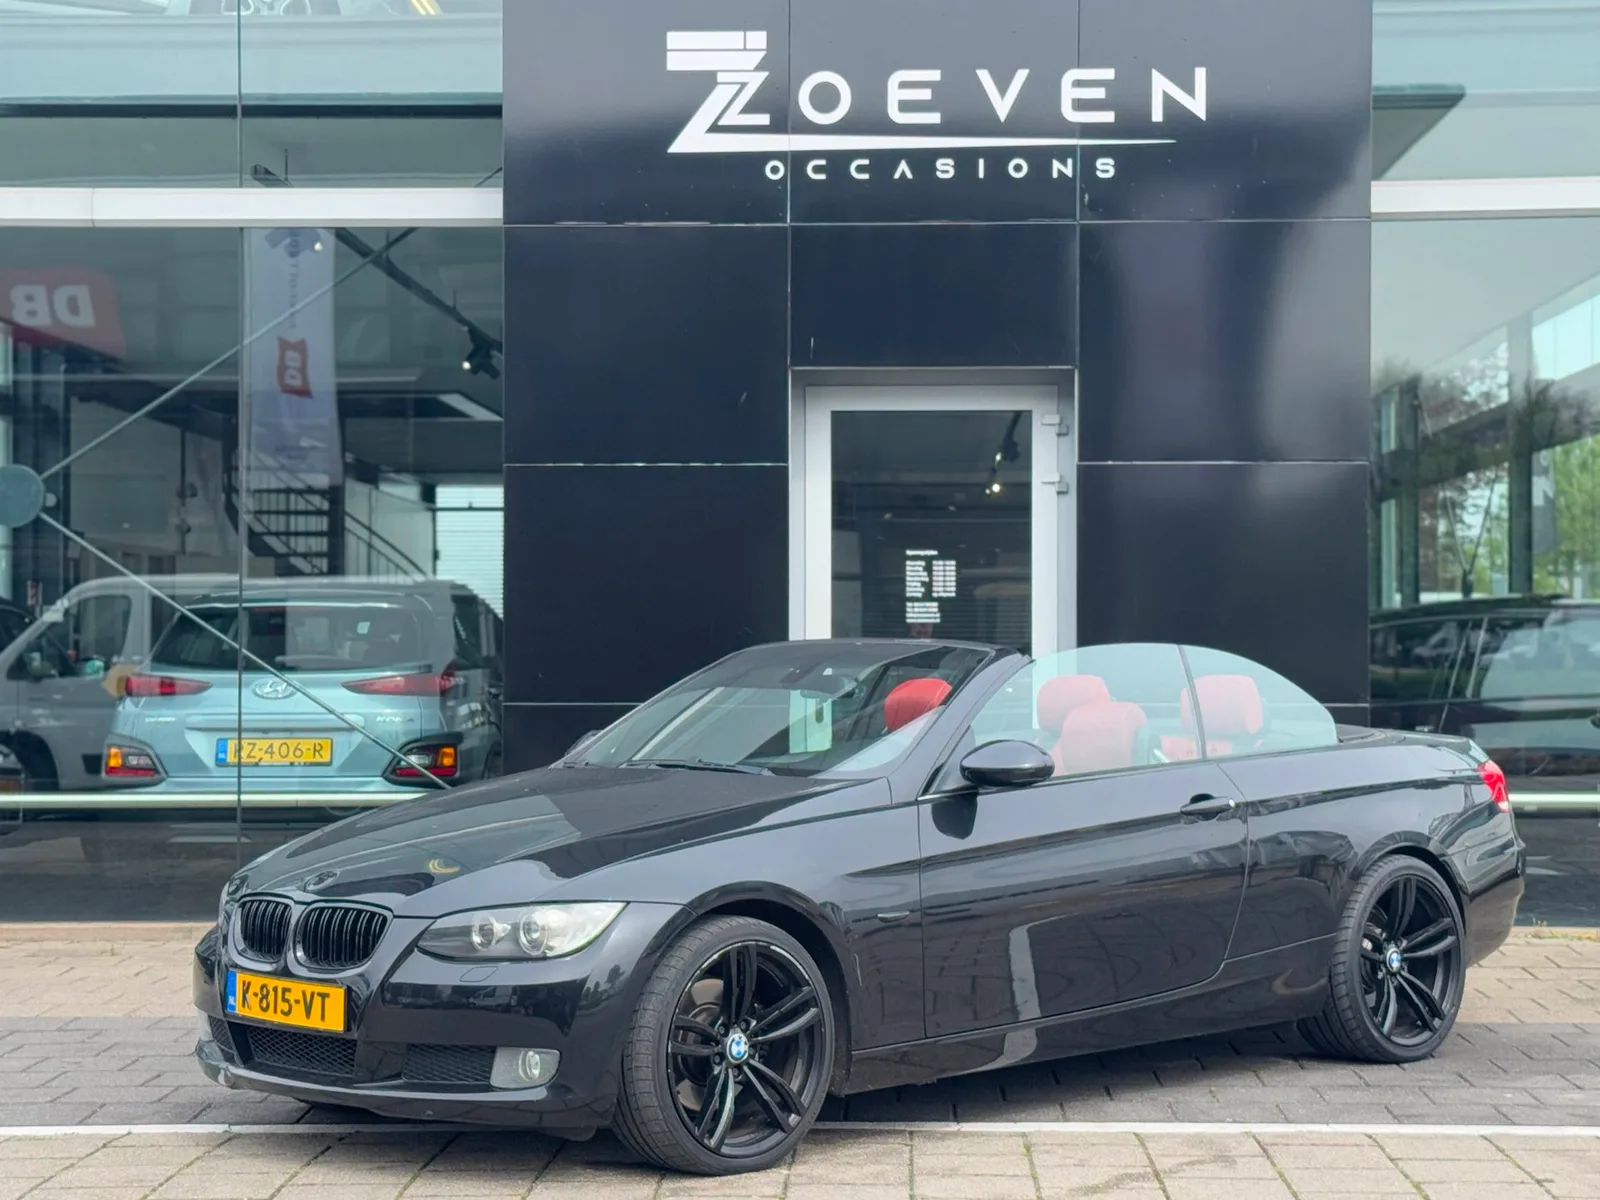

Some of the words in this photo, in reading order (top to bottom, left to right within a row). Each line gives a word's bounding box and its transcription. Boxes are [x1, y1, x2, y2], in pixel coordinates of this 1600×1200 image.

[765, 157, 1117, 180] OCCASIONS
[233, 742, 324, 759] RZ-406-R
[241, 979, 331, 1023] K-815-VT
